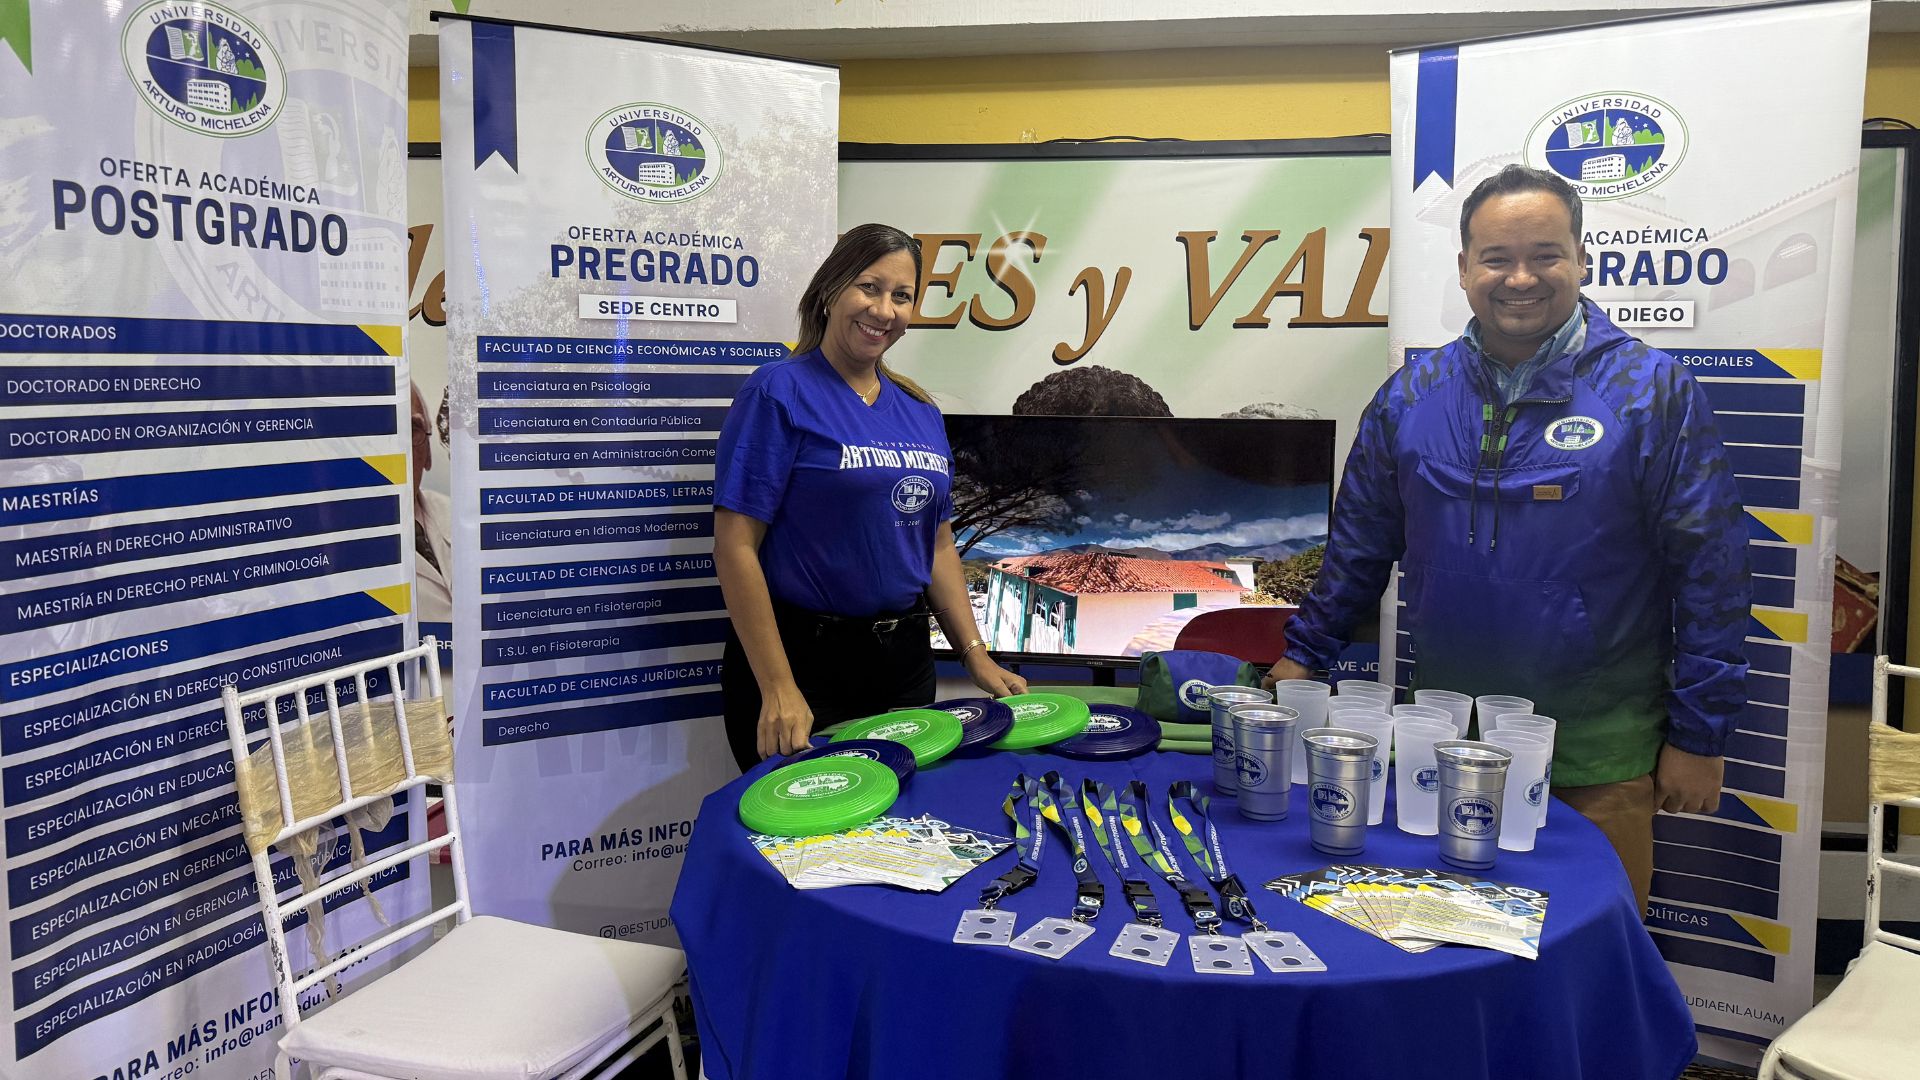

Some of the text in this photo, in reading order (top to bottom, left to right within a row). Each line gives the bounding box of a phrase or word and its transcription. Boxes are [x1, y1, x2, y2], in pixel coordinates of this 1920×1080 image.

[150, 6, 262, 50] UNIVERSIDAD
[143, 79, 271, 130] ARTURO MICHELENA
[1551, 97, 1662, 126] UNIVERSIDAD
[609, 109, 701, 136] UNIVERSIDAD
[100, 156, 320, 205] OFERTA ACADÉMICA
[602, 167, 710, 199] ARTURO MICHELENA
[1592, 162, 1668, 195] MICHELENA
[52, 178, 348, 256] POSTGRADO
[567, 224, 744, 250] OFERTA ACADÉMICA
[1584, 226, 1709, 246] ACADÉMICA
[550, 243, 759, 288] PREGRADO
[598, 300, 720, 317] SEDE CENTRO
[1052, 265, 1132, 366] y
[1617, 307, 1685, 323] DIEGO
[485, 342, 782, 358] FACULTAD DE CIENCIAS ECONÓMICAS Y SOCIALES
[1682, 354, 1754, 368] SOCIALES
[7, 376, 202, 395] DOCTORADO EN DERECHO
[493, 379, 651, 394] Licenciatura en Psicología
[9, 416, 315, 448] DOCTORADO EN ORGANIZACIÓN Y GERENCIA
[493, 413, 702, 429] Licenciatura en Contaduría Pública
[494, 449, 570, 463] Licenciatura
[573, 451, 589, 462] en
[592, 447, 679, 461] Administración
[839, 443, 902, 470] ARTURO
[2, 489, 100, 513] MAESTRÍAS
[488, 485, 713, 506] FACULTAD DE HUMANIDADES, LETRAS
[15, 516, 293, 568] MAESTRÍA EN DERECHO ADMINISTRATIVO
[495, 519, 699, 542] Licenciatura en Idiomas Modernos
[17, 551, 330, 621] MAESTRÍA EN DERECHO PENAL Y CRIMINOLOGÍA
[488, 558, 713, 585] FACULTAD DE CIENCIAS DE LA SALUD
[496, 597, 662, 622] Licenciatura en Fisioterapia
[497, 635, 620, 658] T.S.U. en Fisioterapia
[10, 638, 170, 688] ESPECIALIZACIONES
[24, 646, 343, 740] ESPECIALIZACIÓN EN DERECHO CONSTITUCIONAL
[490, 682, 557, 701] FACULTAD
[560, 680, 577, 692] DE
[579, 674, 638, 690] CIENCIAS
[641, 665, 703, 683] JURÍDICAS
[706, 665, 715, 675] Y
[25, 736, 152, 791] ESPECIALIZACIÓN
[156, 731, 175, 750] EN
[306, 691, 326, 706] DEL
[498, 719, 550, 737] Derecho
[28, 786, 155, 841] ESPECIALIZACIÓN
[158, 778, 177, 796] EN
[29, 832, 156, 892] ESPECIALIZACIÓN
[159, 822, 179, 840] EN
[541, 837, 594, 862] PARA
[600, 826, 643, 852] MÁS
[573, 853, 627, 872] Correo:
[31, 842, 247, 941] ESPECIALIZACIÓN EN GERENCIA
[33, 924, 161, 991] ESPECIALIZACIÓN
[164, 915, 182, 932] EN
[184, 886, 249, 922] GERENCIA
[618, 916, 675, 937] @ESTUDI
[35, 969, 162, 1040] ESPECIALIZACIÓN
[166, 957, 184, 977] EN
[186, 924, 265, 967] RADIOLOGÍA
[167, 1022, 218, 1064] MÁS
